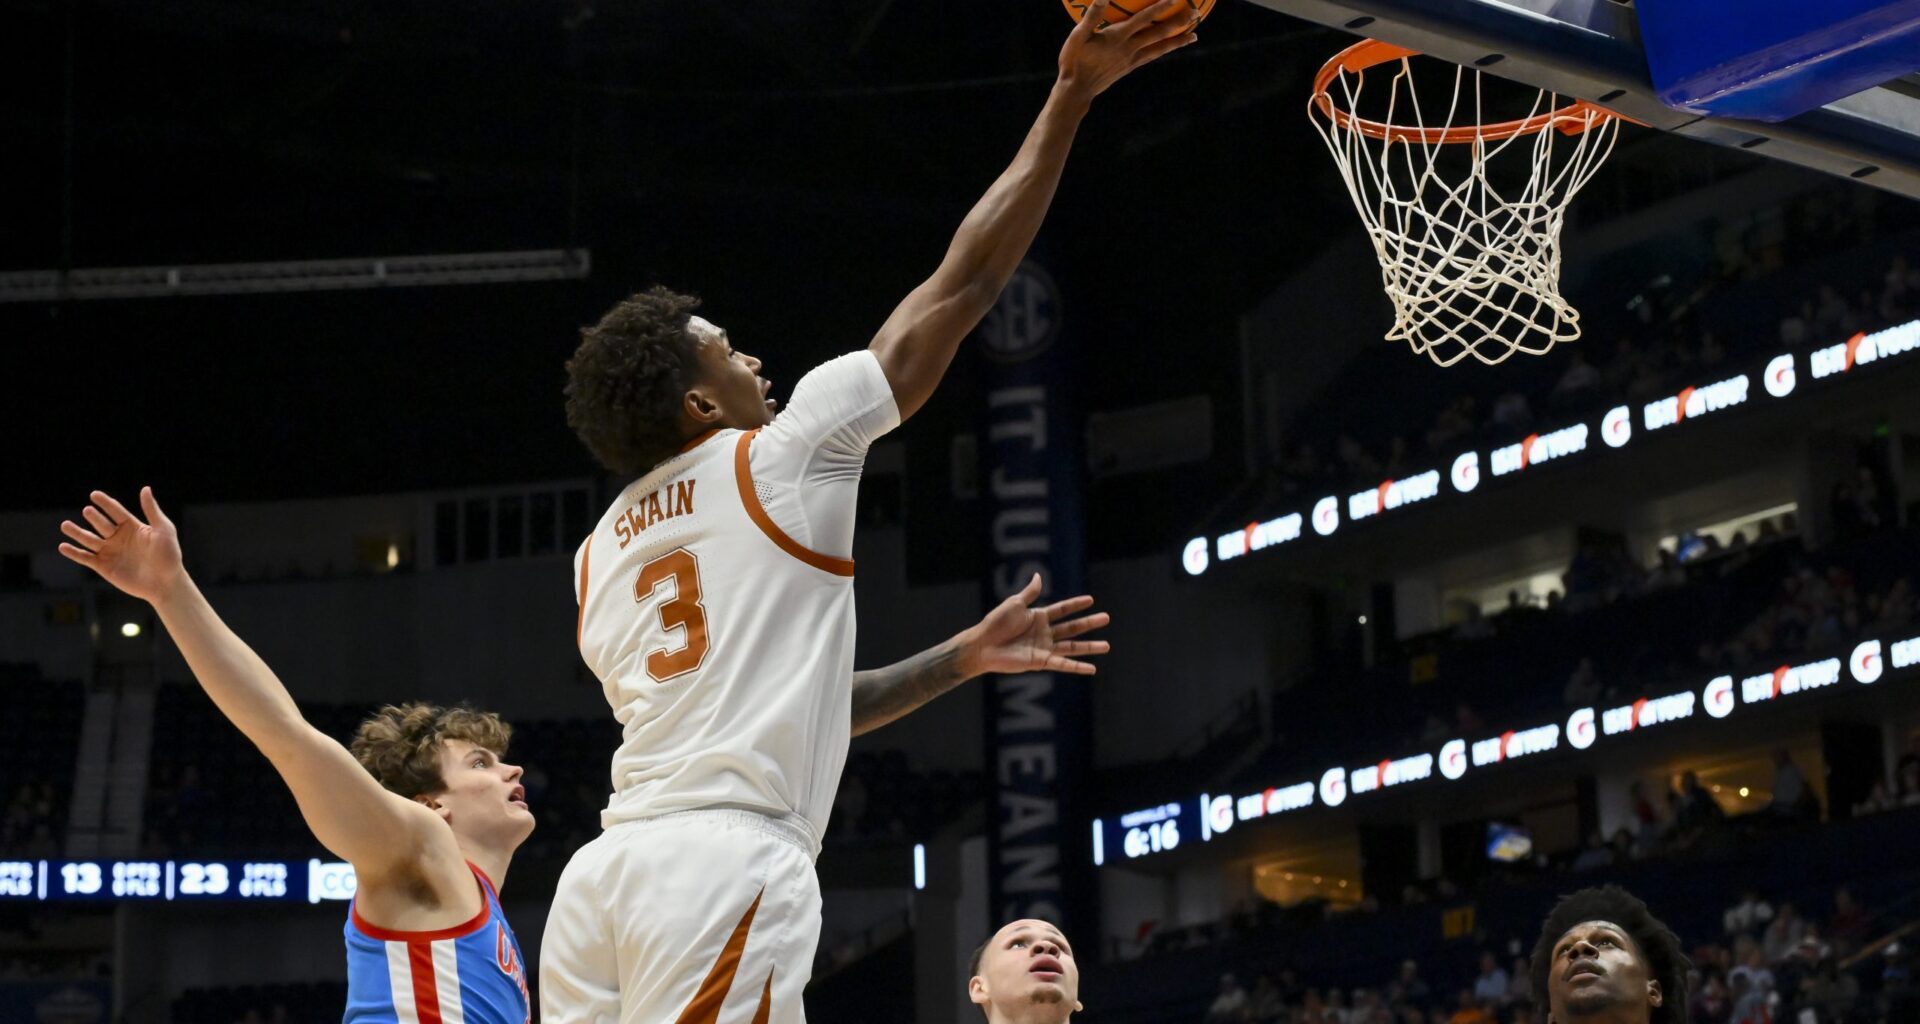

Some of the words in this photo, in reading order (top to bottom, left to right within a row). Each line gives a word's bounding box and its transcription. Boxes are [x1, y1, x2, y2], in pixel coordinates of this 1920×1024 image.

[988, 386, 1048, 450] IT
[614, 479, 695, 550] SWAIN
[990, 462, 1053, 600] JUS
[633, 546, 711, 683] 3
[1124, 819, 1180, 858] 6:16
[61, 863, 102, 894] 13
[180, 863, 229, 894] 23
